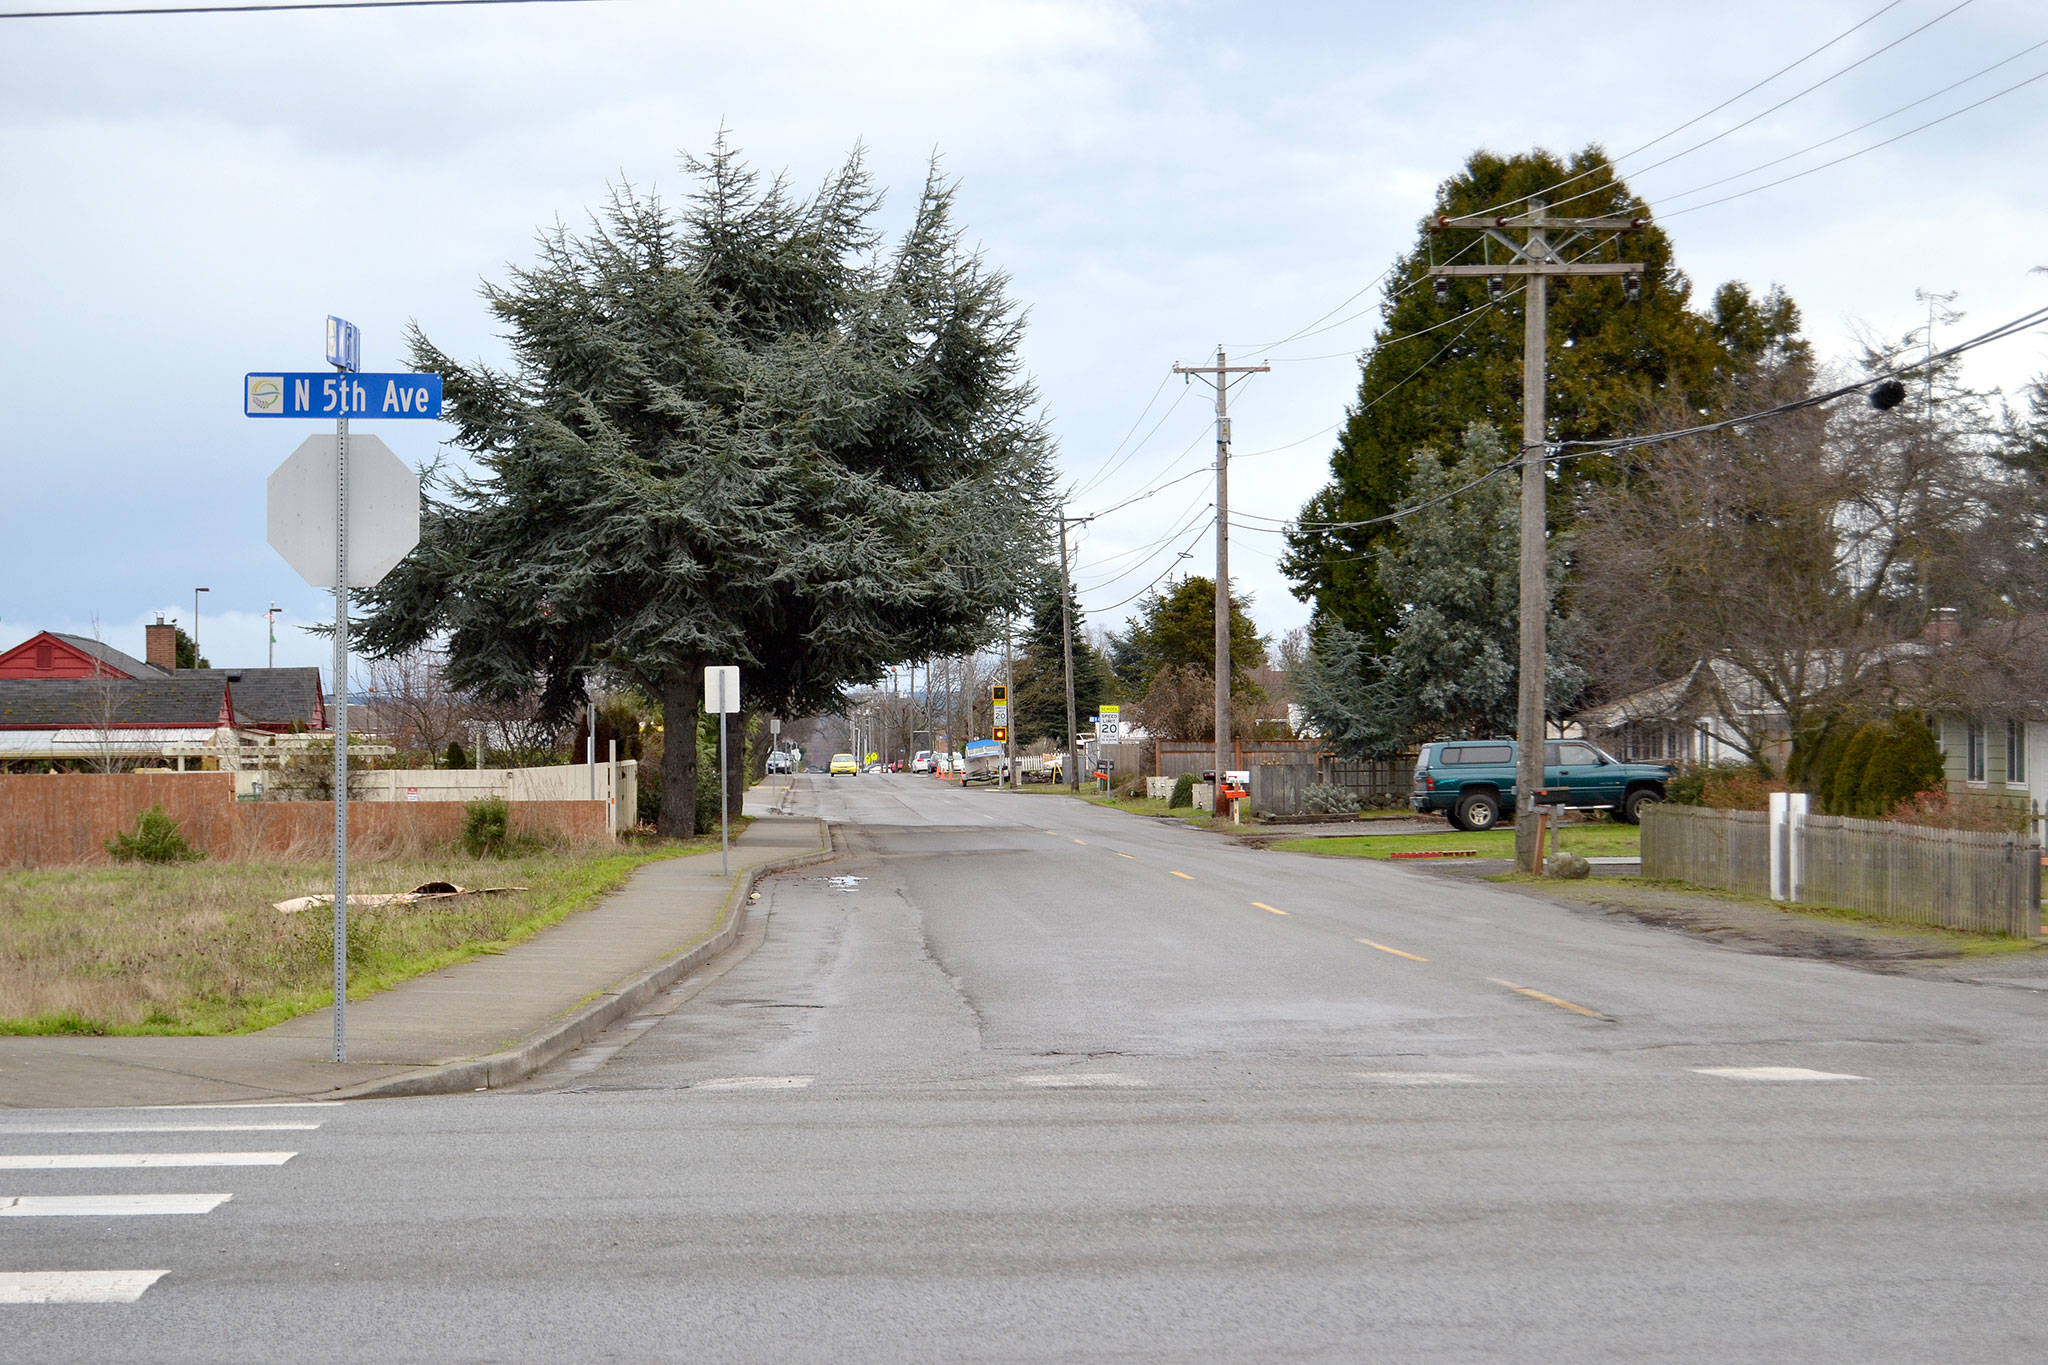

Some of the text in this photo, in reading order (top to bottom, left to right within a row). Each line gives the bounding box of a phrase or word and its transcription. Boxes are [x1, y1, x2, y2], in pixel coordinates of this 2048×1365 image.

[295, 379, 430, 412] N 5th Ave
[995, 712, 1006, 720] 20
[1101, 724, 1117, 733] 20
